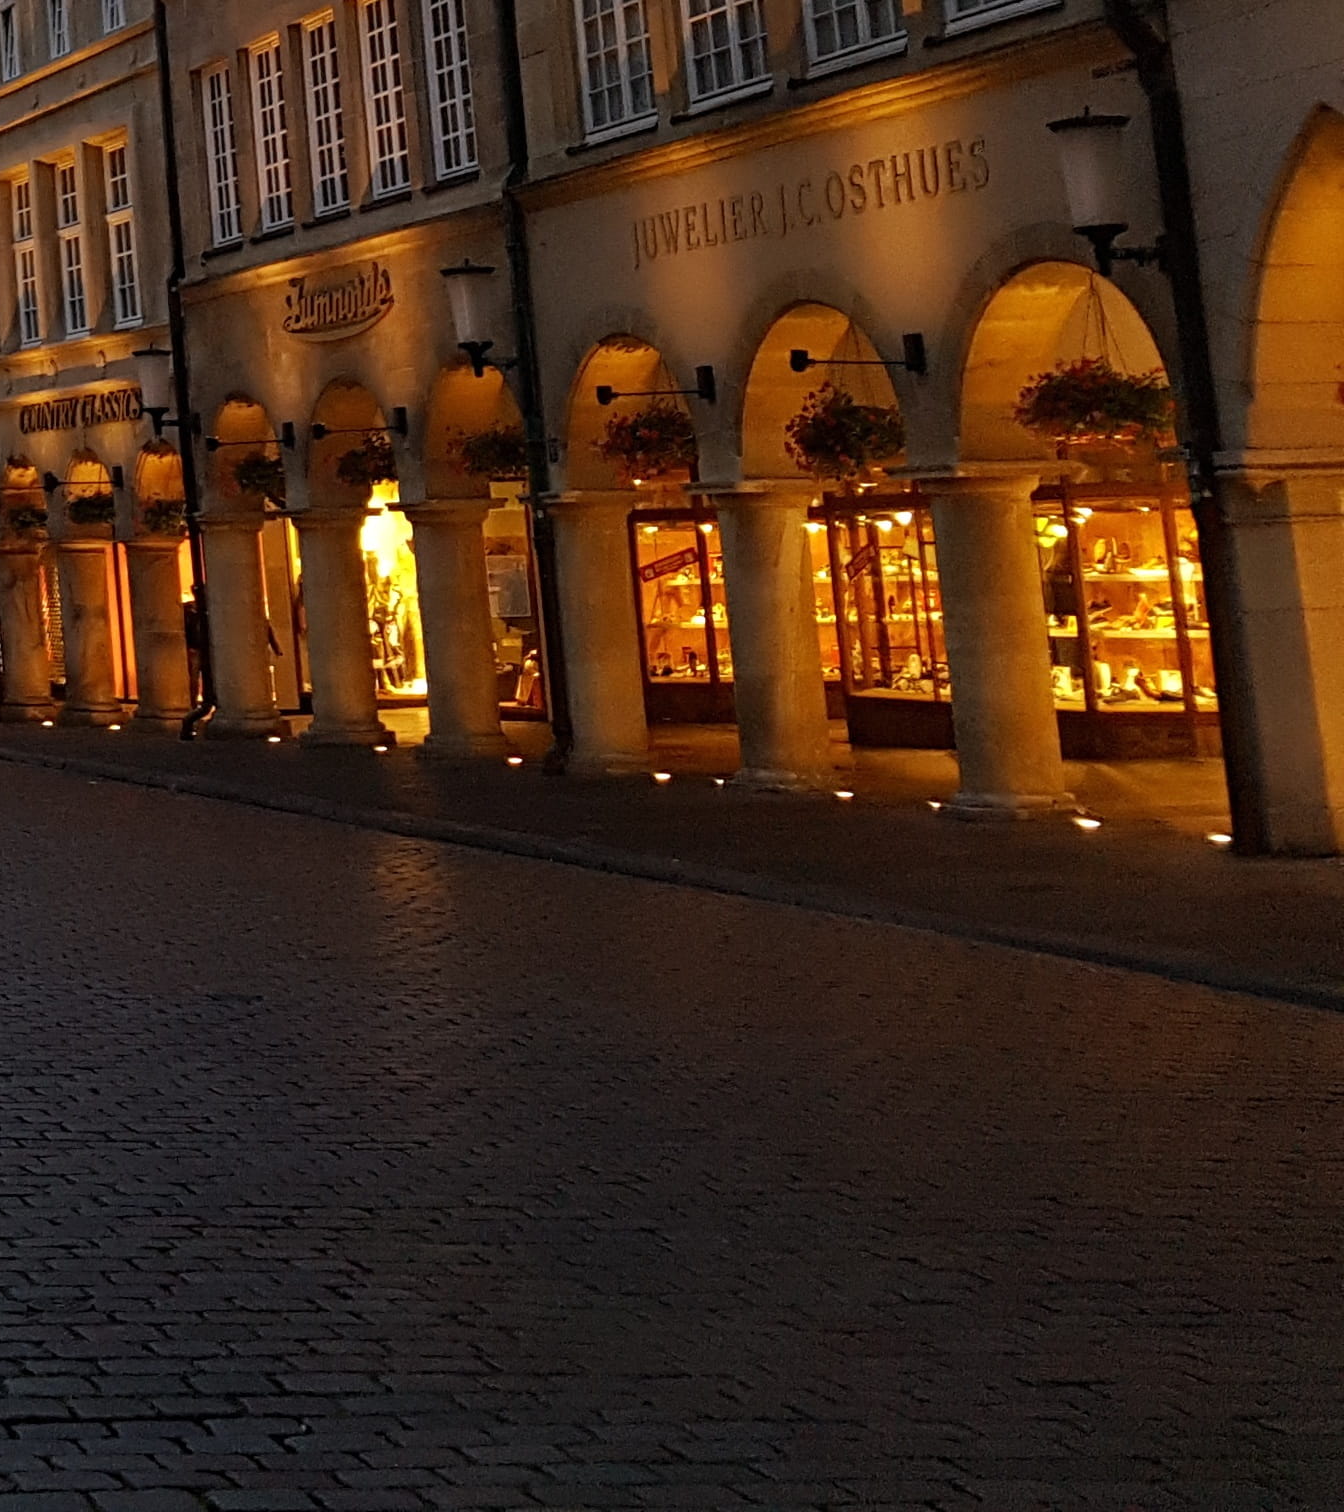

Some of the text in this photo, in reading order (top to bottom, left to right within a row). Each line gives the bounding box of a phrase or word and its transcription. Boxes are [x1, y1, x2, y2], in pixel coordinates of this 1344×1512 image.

[631, 191, 768, 271] JUWELIER
[825, 136, 991, 221] OSTHUES
[19, 386, 144, 435] COUNTRY CLASSICS
